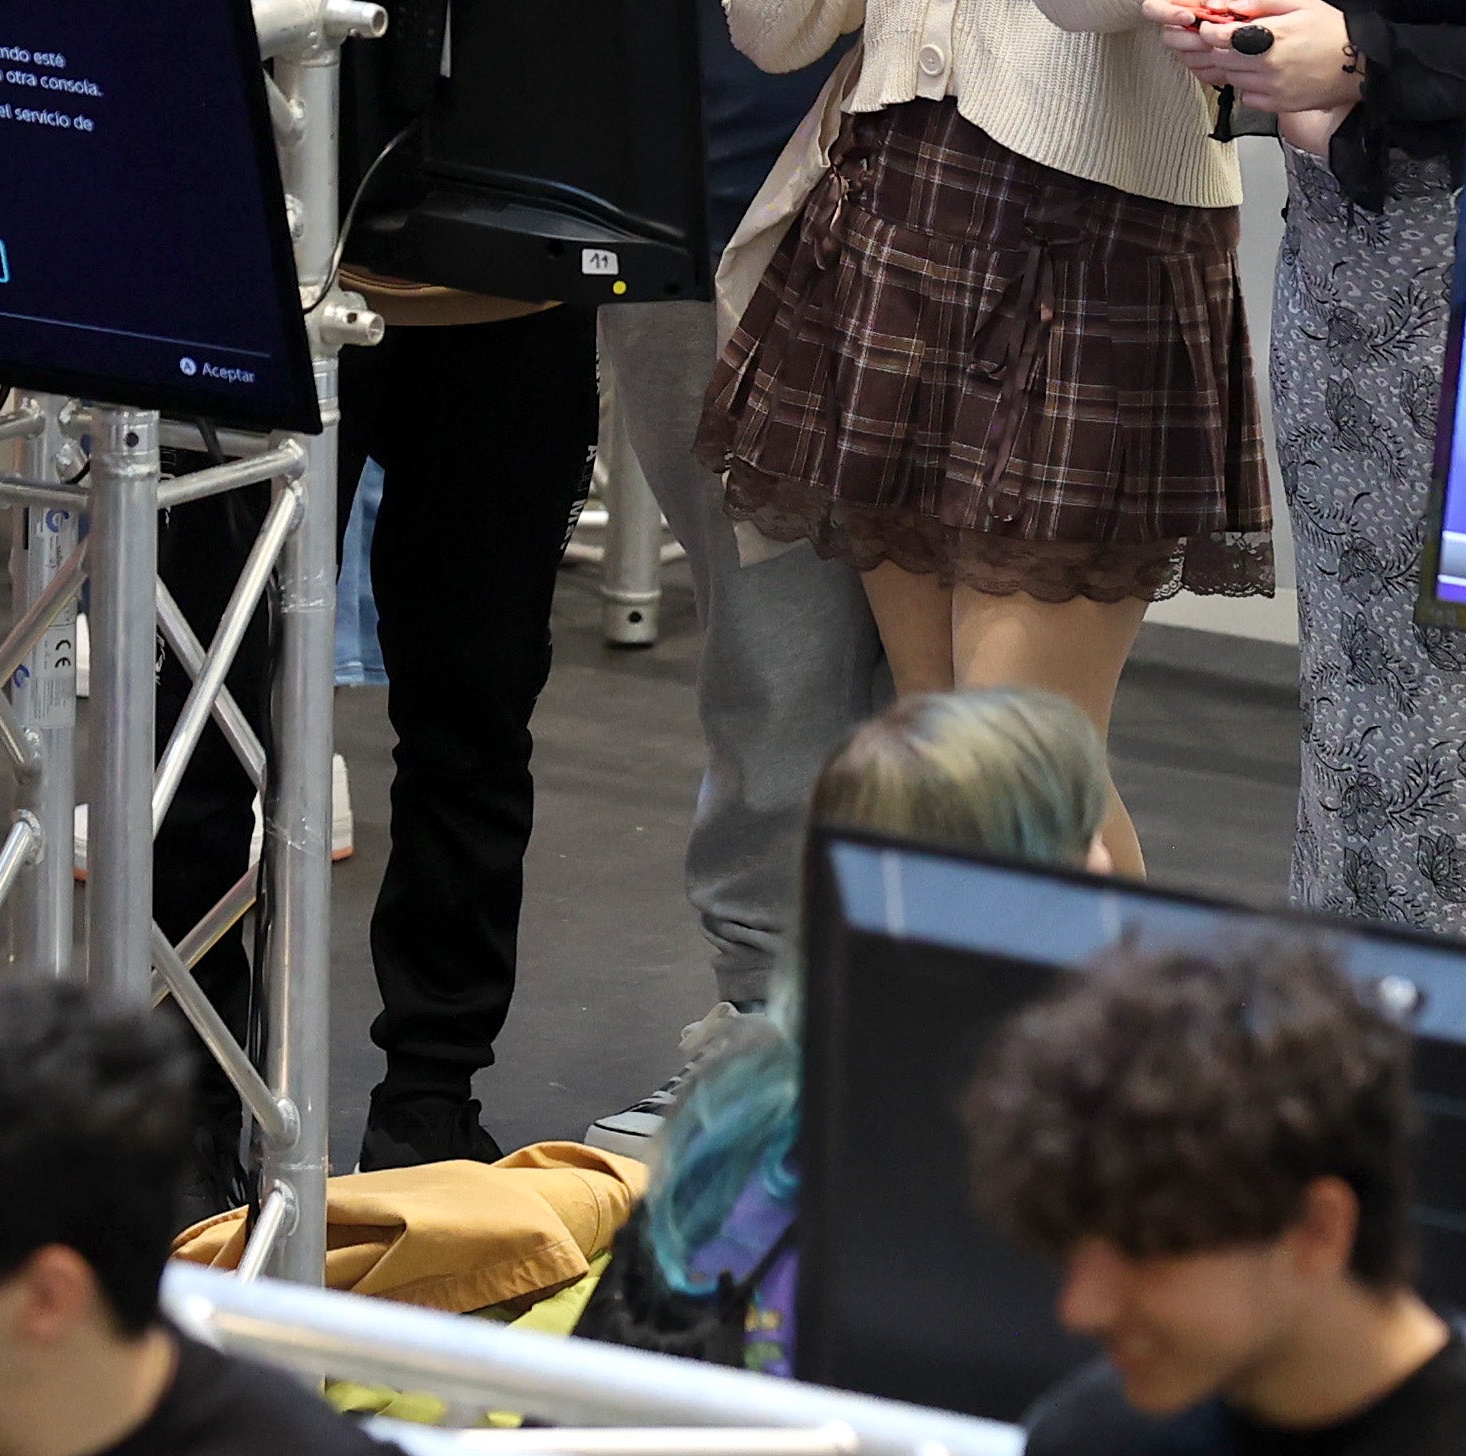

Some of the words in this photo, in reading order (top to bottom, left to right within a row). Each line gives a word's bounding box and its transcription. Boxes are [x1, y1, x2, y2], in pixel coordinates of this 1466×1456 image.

[33, 52, 65, 67] esté
[6, 71, 37, 86] otra
[40, 77, 101, 96] consola.
[14, 109, 70, 127] servicio
[73, 115, 93, 131] de
[202, 362, 255, 383] Aceptar
